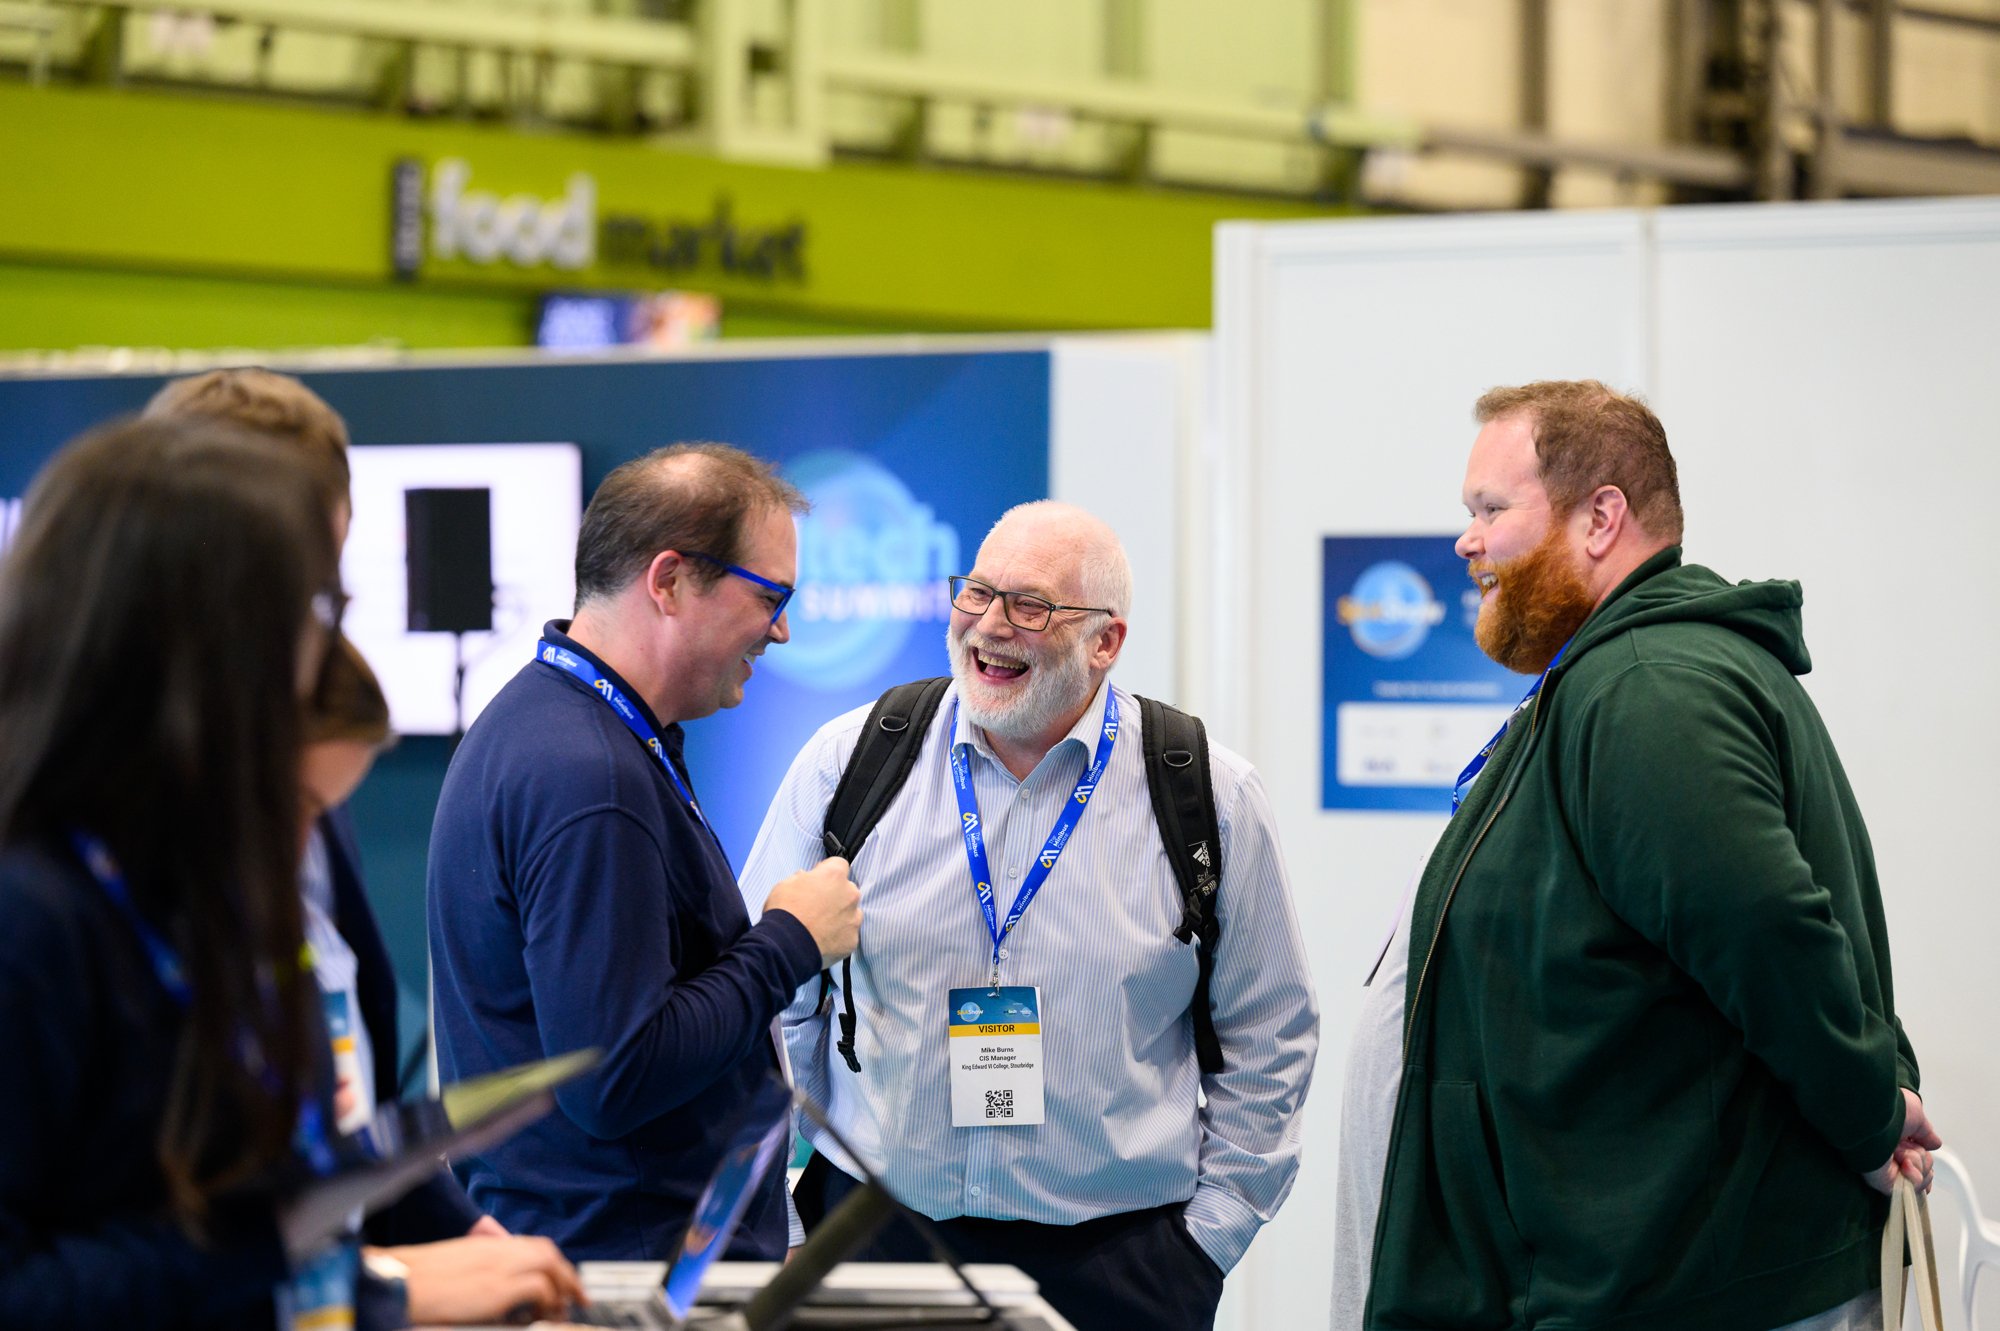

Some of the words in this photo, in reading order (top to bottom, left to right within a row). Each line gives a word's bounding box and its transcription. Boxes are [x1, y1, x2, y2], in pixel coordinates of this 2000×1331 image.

[432, 159, 596, 268] food
[1087, 760, 1102, 783] Minibus
[1053, 824, 1069, 847] Minibus
[1017, 888, 1033, 912] Minibus
[978, 1024, 1015, 1033] VISITOR
